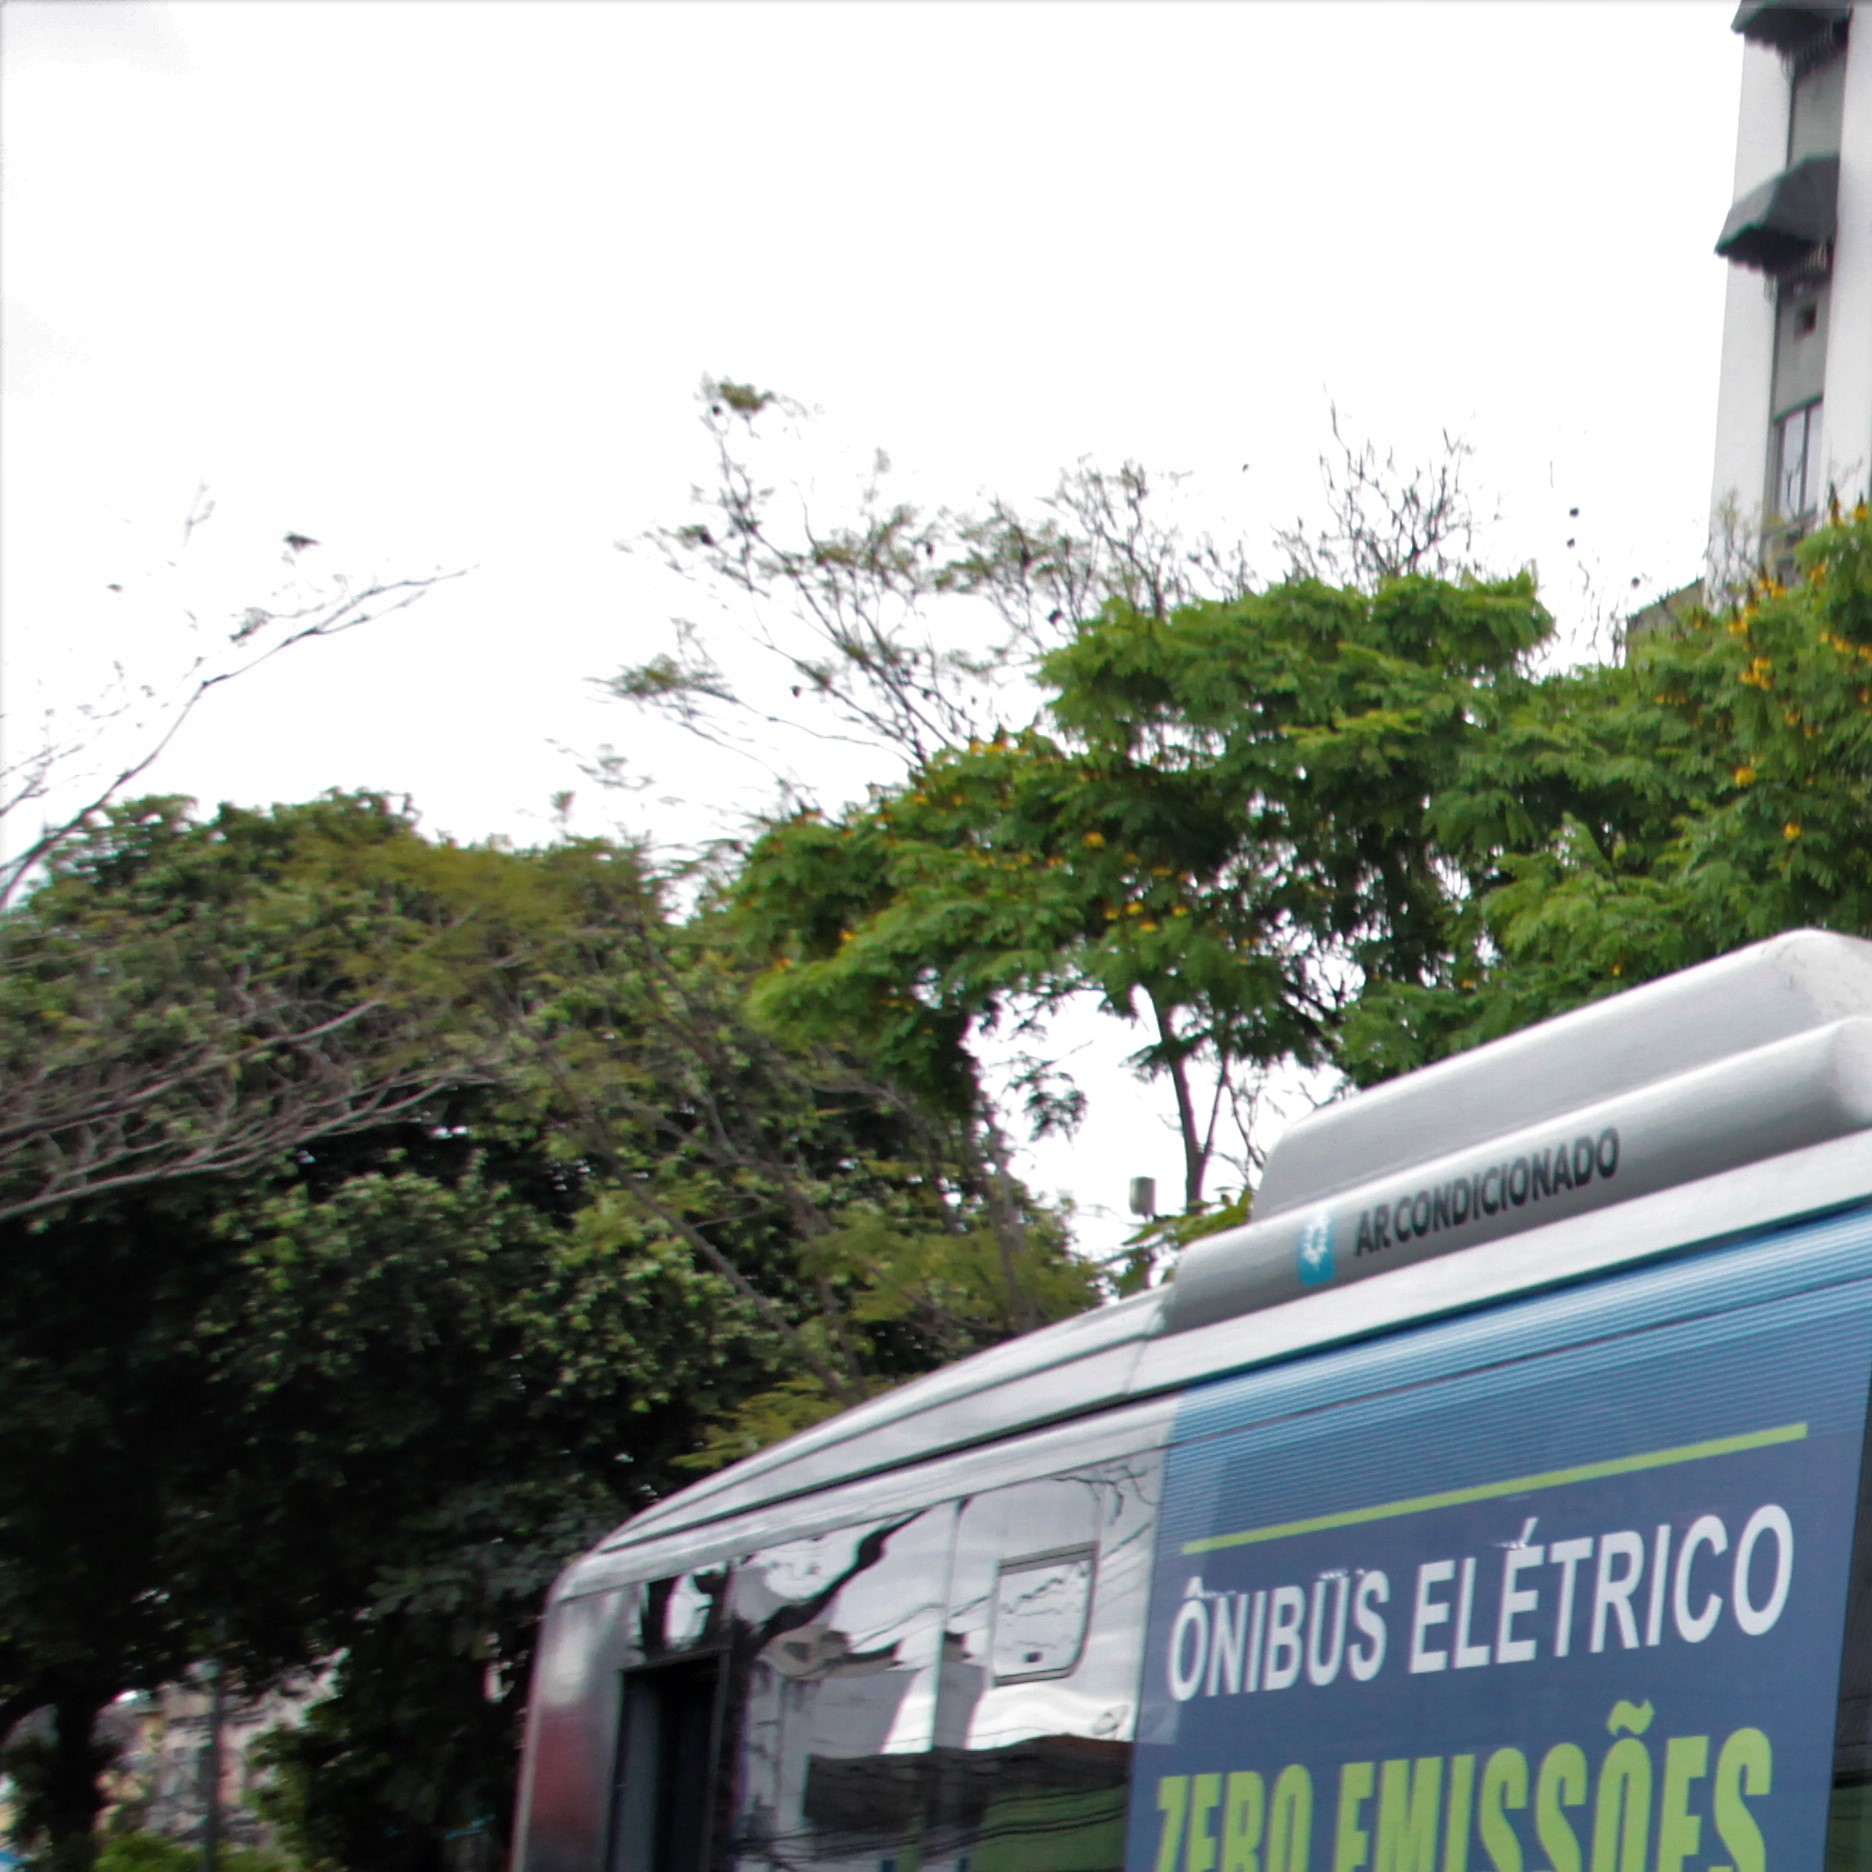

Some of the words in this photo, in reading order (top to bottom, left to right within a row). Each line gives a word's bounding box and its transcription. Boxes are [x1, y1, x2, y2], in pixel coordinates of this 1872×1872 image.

[1354, 1209, 1391, 1258] AR
[1394, 1127, 1620, 1244] CONDICIONADO
[1166, 1574, 1389, 1702] ÔNIBUS
[1409, 1504, 1793, 1674] ELÉTRICO
